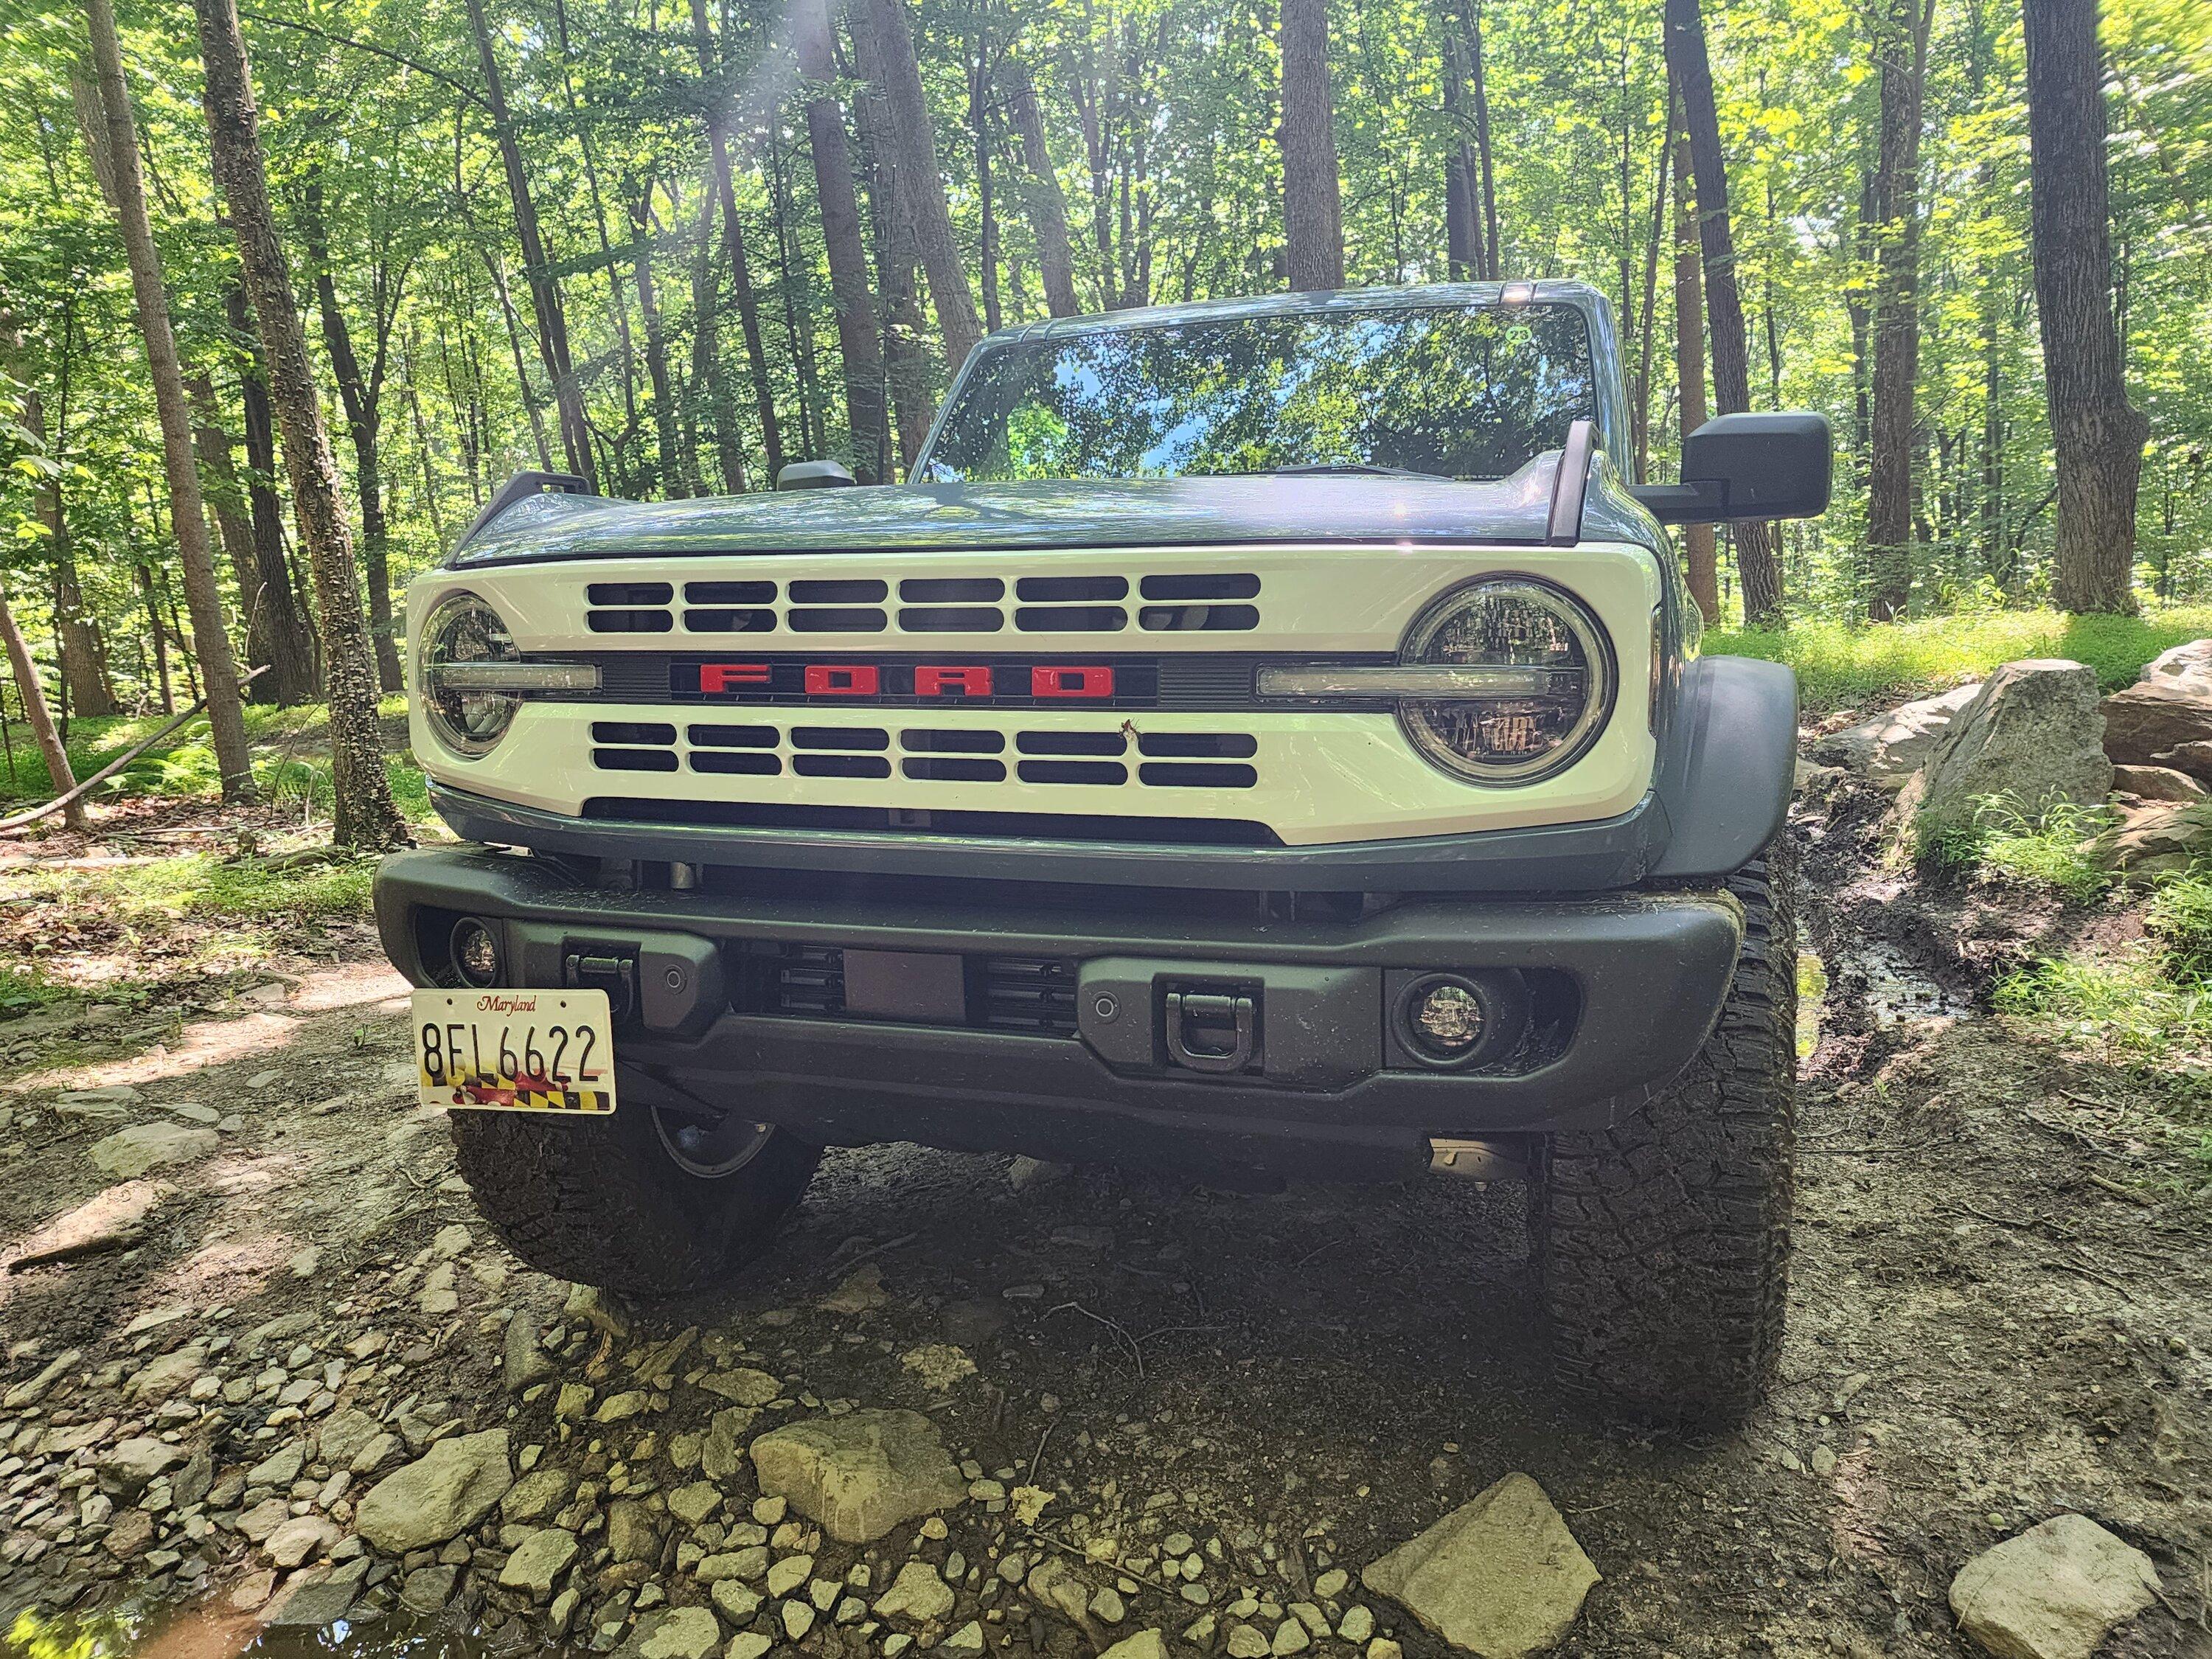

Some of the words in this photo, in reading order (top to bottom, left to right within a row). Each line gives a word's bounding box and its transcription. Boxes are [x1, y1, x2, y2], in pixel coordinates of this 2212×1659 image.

[700, 664, 1113, 697] FORD
[476, 995, 537, 1017] Maryland
[422, 1023, 599, 1082] 8FL6622
